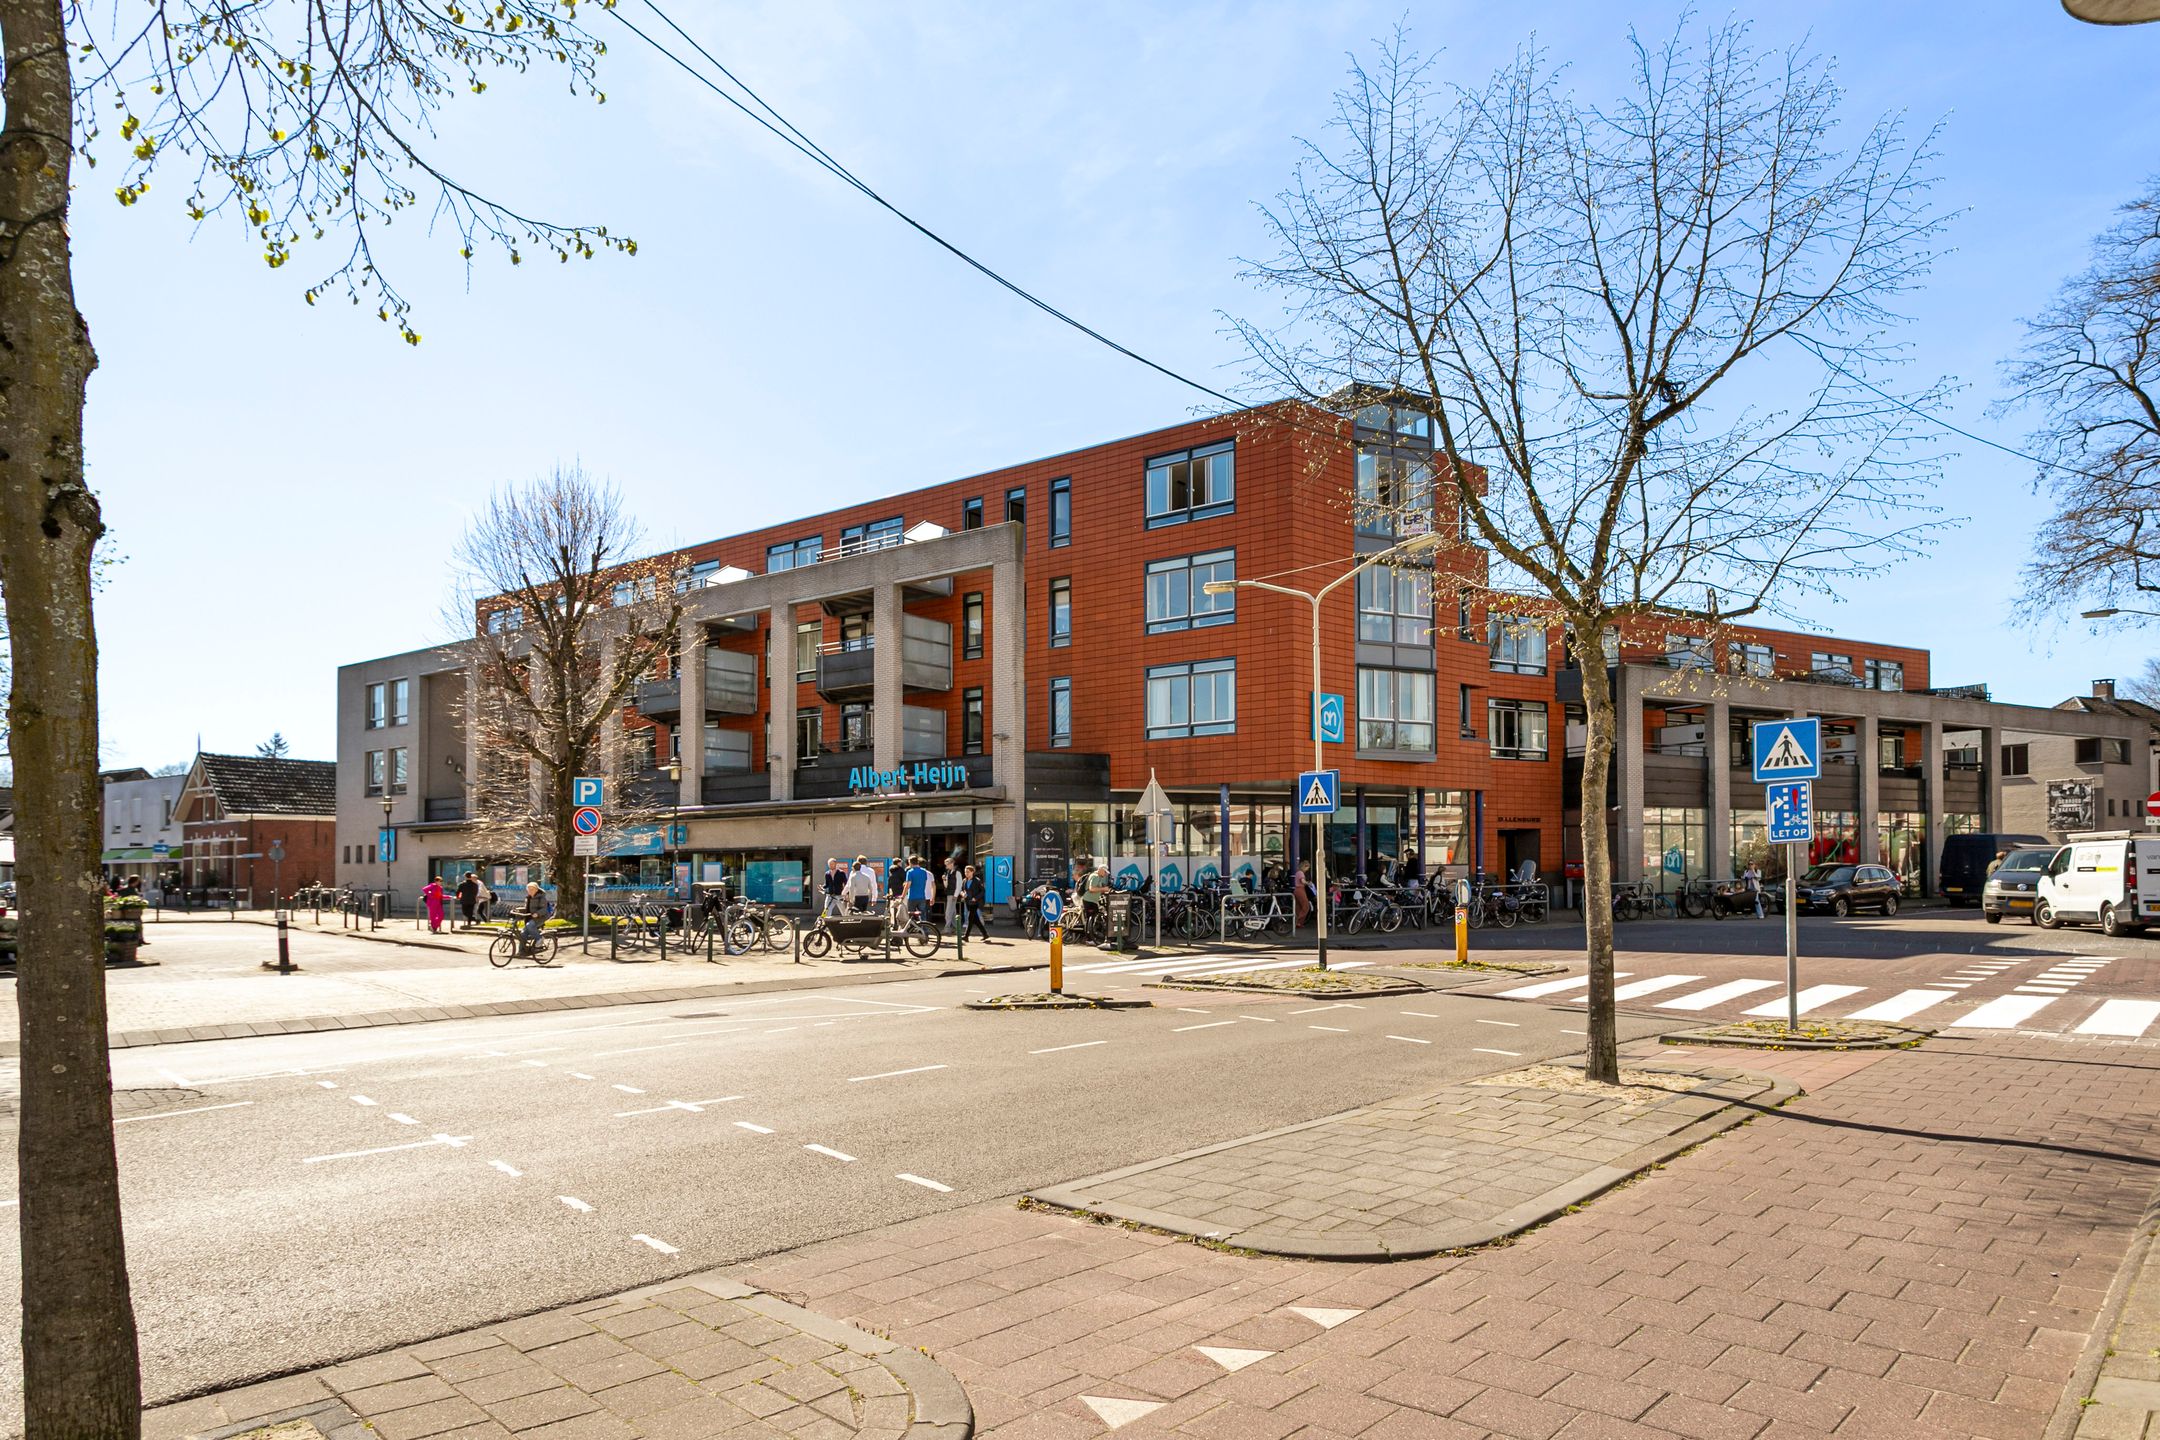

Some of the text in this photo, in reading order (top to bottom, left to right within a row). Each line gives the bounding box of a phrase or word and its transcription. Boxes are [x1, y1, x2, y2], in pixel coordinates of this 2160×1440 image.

[849, 761, 966, 789] Albert Heijn
[580, 781, 597, 803] P
[1772, 828, 1807, 838] LET OP
